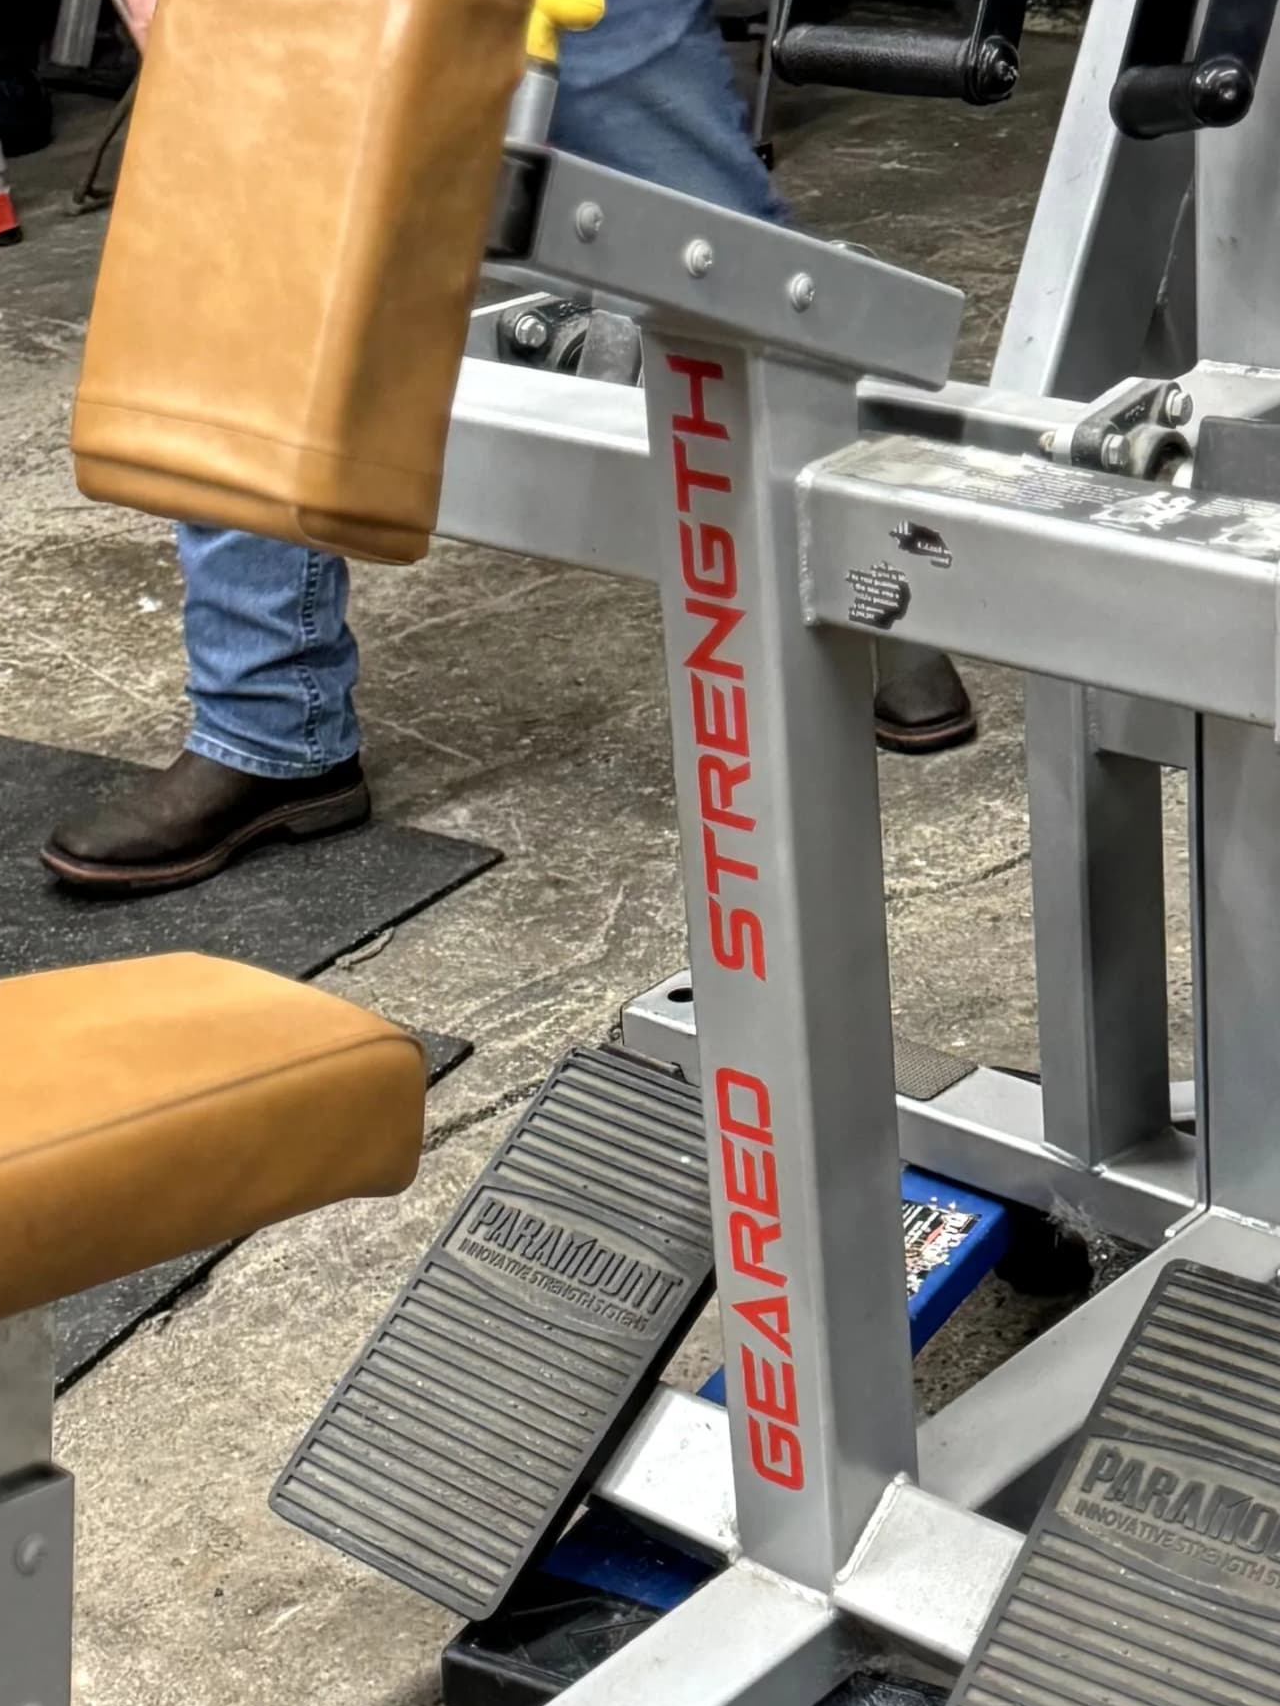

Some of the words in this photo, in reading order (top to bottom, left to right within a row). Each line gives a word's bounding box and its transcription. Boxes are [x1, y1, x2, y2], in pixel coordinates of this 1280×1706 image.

[666, 354, 768, 981] STRENGTH
[457, 1237, 531, 1280] INNOVATIVE
[529, 1269, 593, 1310] STRENGTH
[467, 1196, 684, 1315] PARAMOUNT
[715, 1066, 805, 1491] GEARED
[1073, 1497, 1176, 1550] INNOVATIVE
[1174, 1532, 1267, 1581] STRENGTH
